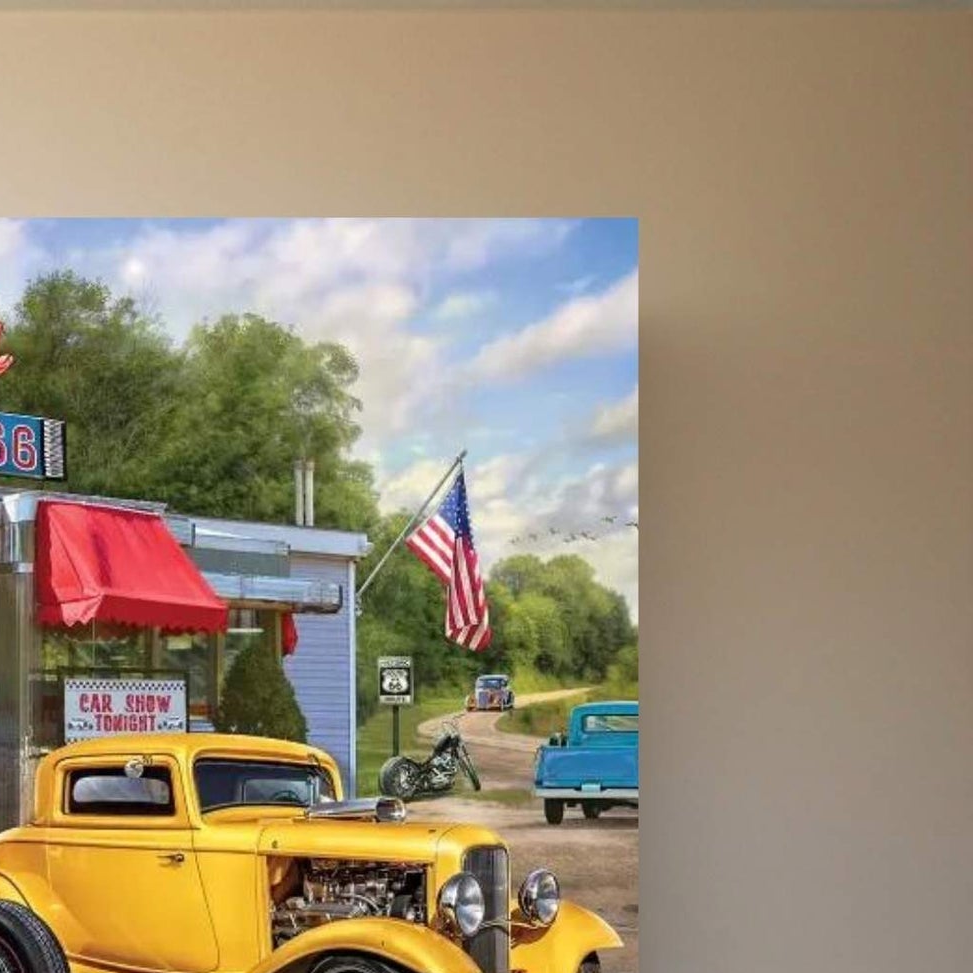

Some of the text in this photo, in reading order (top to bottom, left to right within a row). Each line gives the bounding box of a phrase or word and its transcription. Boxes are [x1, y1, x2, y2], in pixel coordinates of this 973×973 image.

[78, 693, 172, 713] CAR SHOW
[94, 713, 156, 732] TONIGHT
